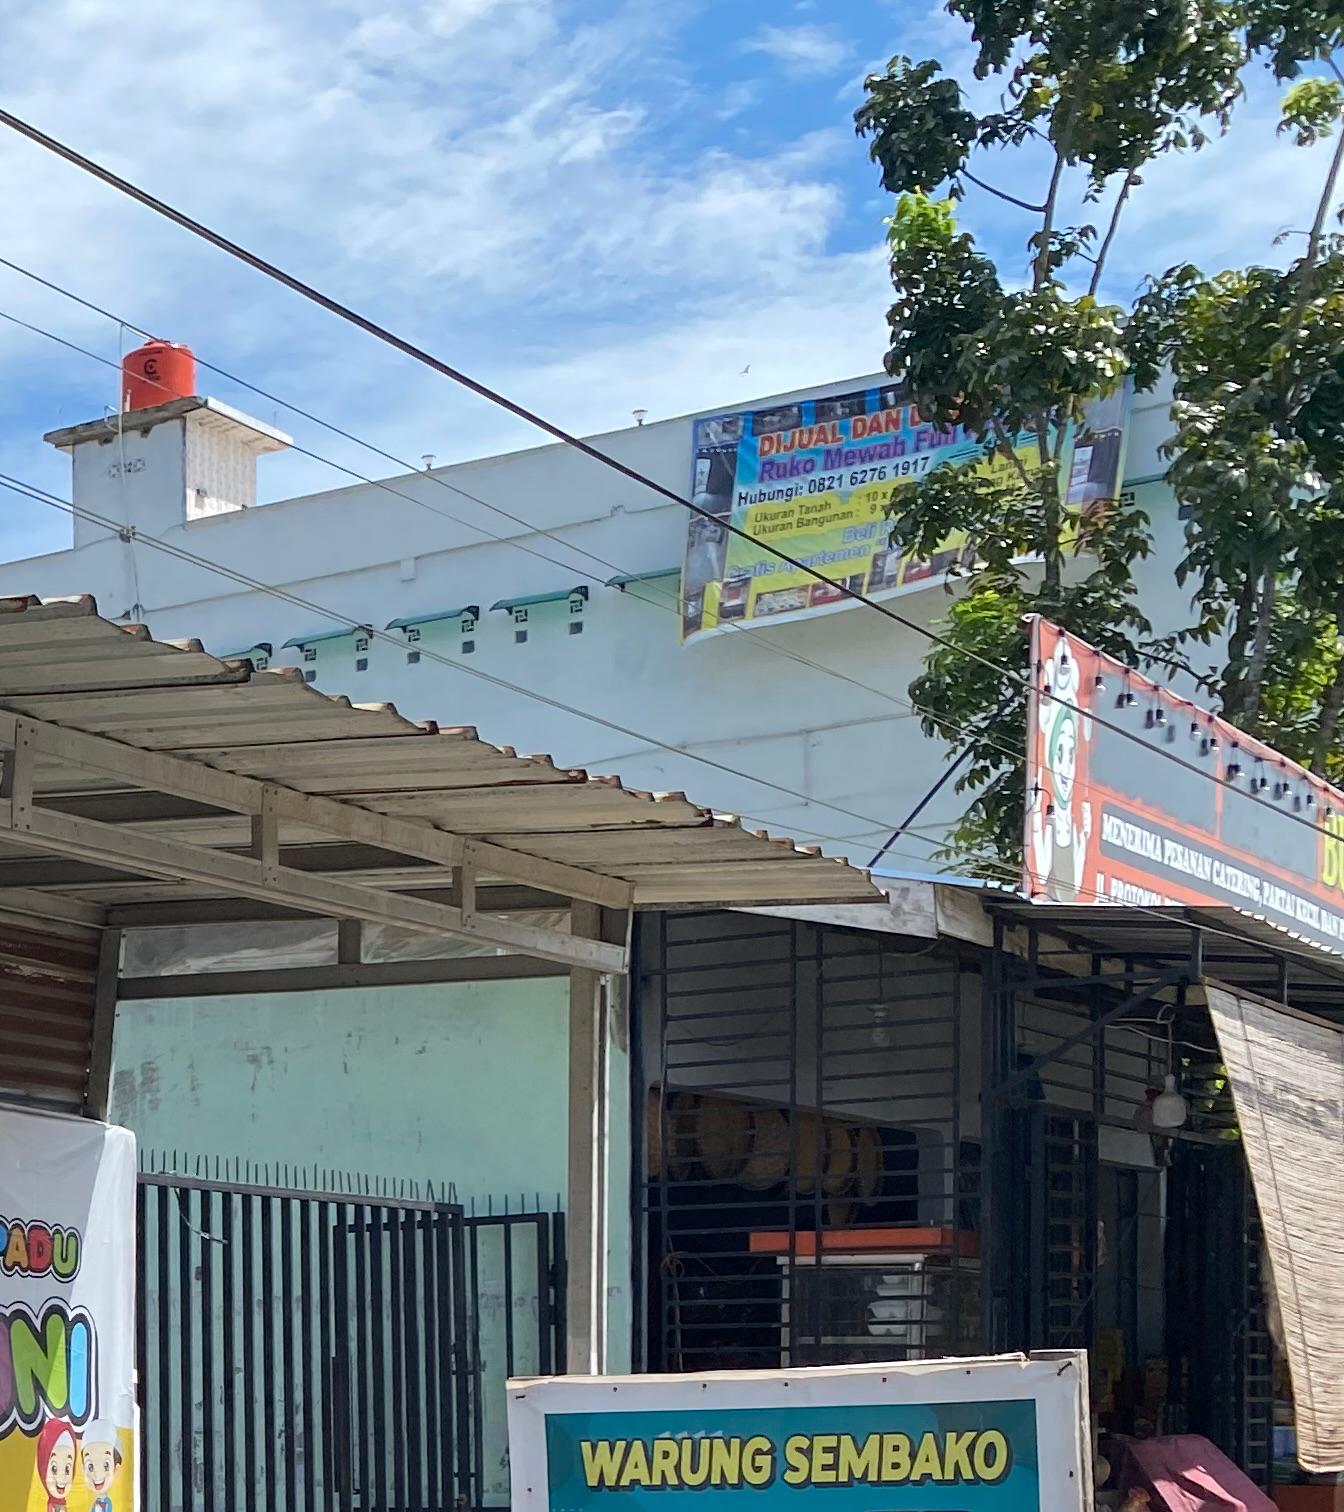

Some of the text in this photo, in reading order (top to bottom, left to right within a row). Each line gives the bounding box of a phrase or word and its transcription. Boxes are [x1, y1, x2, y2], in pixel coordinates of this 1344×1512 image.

[758, 423, 845, 458] DIJUAL
[851, 408, 902, 439] DAN
[737, 456, 930, 507] Hubungi: 0821 6276 1917
[758, 454, 816, 483] Ruko
[823, 435, 906, 471] Mewah
[752, 521, 793, 536] Ukuran
[796, 510, 854, 529] Bangunan
[755, 509, 795, 523] Ukuran
[798, 500, 832, 514] Tanah
[1102, 812, 1162, 863] MENERIMA
[1163, 838, 1213, 882] PESANAN
[1262, 881, 1296, 918] PARTAI
[580, 1430, 1011, 1490] WARUNG SEMBAKO
